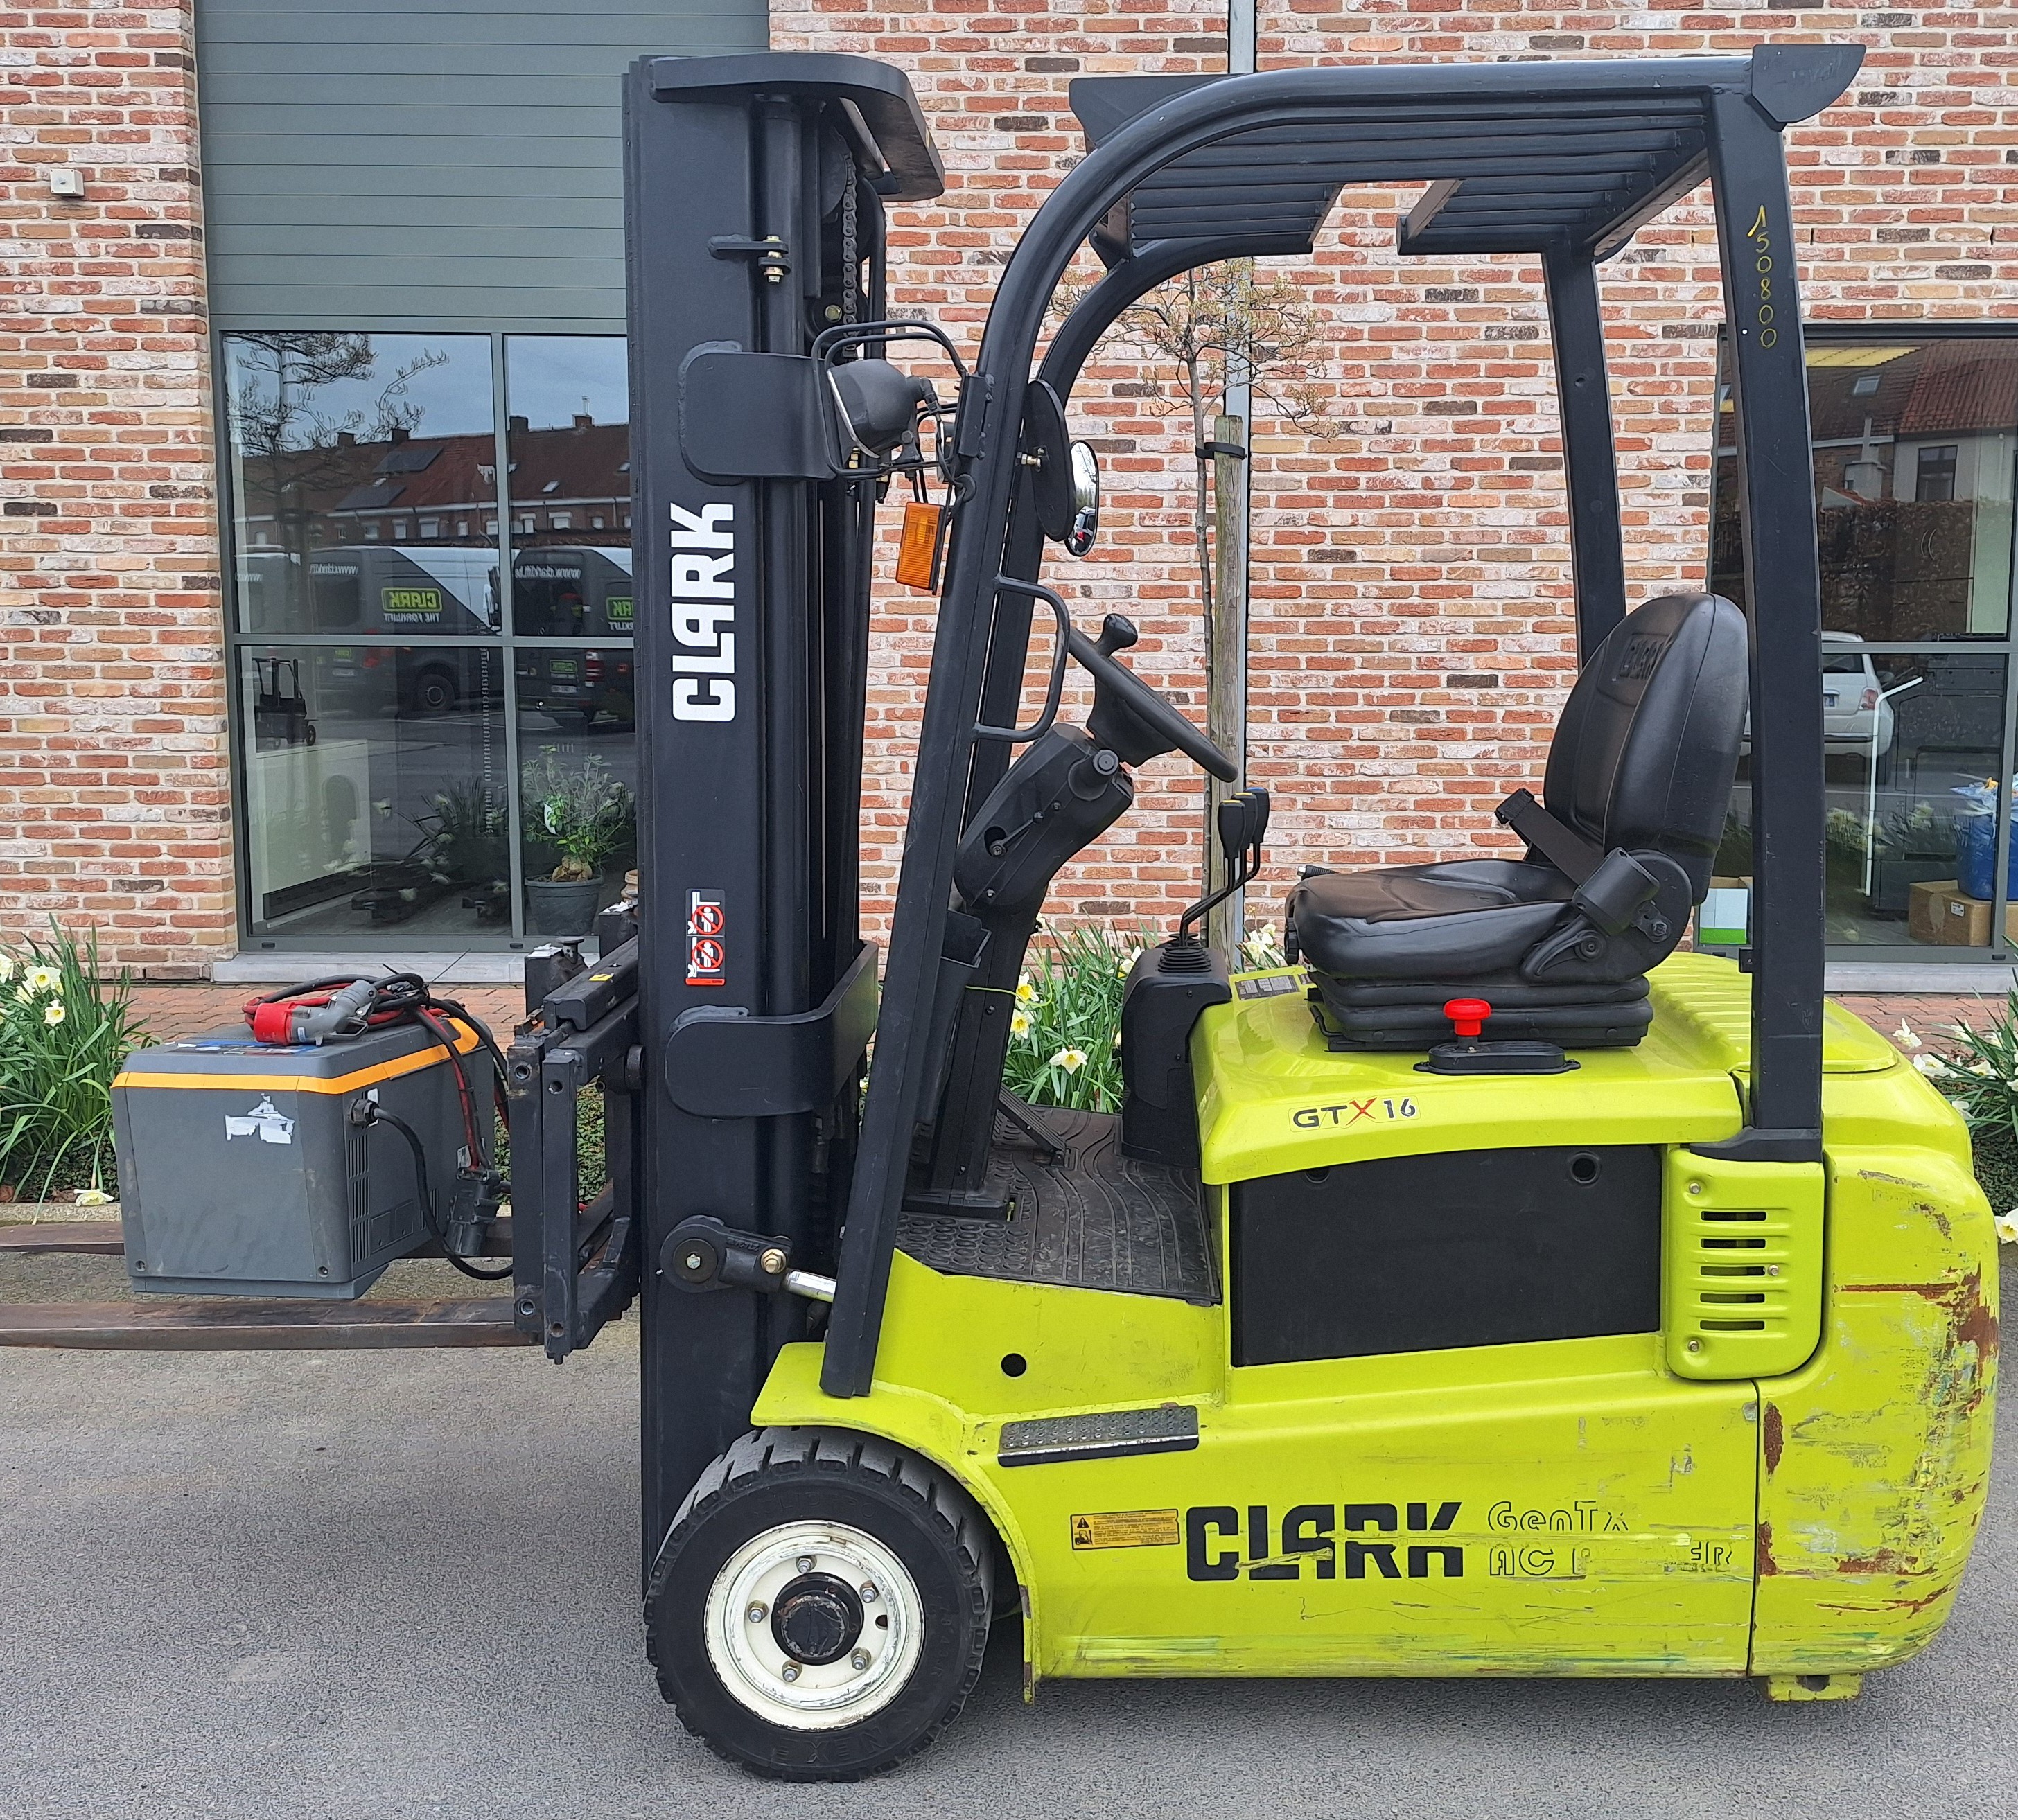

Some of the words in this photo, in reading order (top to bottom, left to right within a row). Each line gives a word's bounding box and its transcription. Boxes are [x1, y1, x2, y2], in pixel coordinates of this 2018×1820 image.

[1746, 204, 1777, 349] 150800
[669, 502, 736, 723] CLARK
[1186, 1501, 1464, 1582] CLARK
[1489, 1546, 1555, 1576] AC
